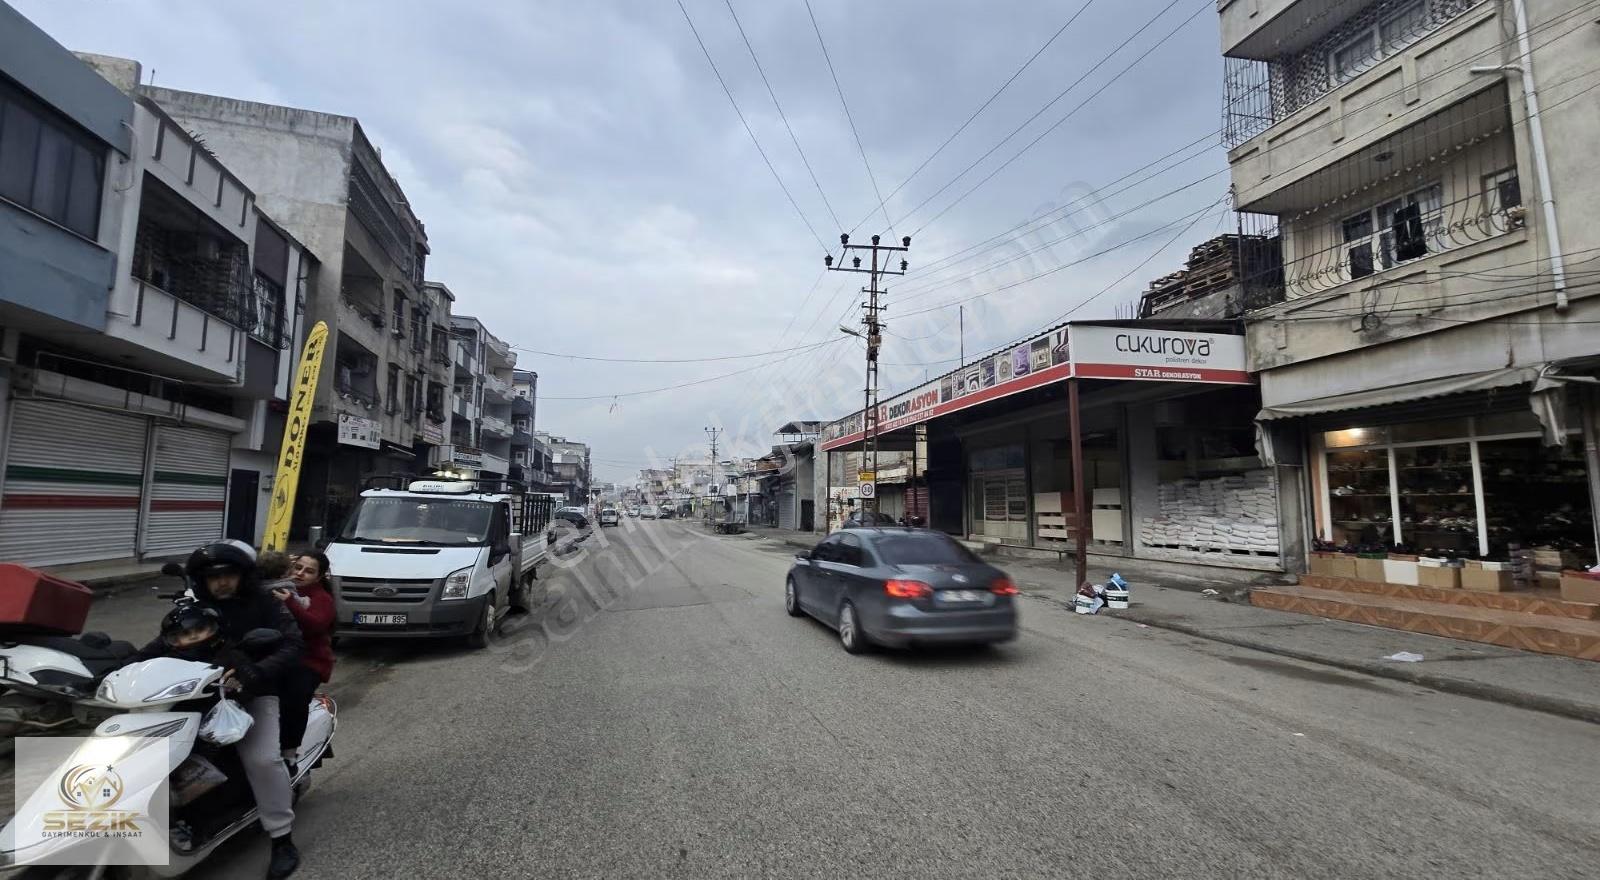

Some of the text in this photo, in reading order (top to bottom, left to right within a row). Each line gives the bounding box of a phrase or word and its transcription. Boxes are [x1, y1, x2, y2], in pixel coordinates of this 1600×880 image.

[1134, 368, 1202, 379] STAR DEKORASYON
[889, 389, 938, 419] DEKORASYON
[359, 615, 406, 623] 01 AVT 895
